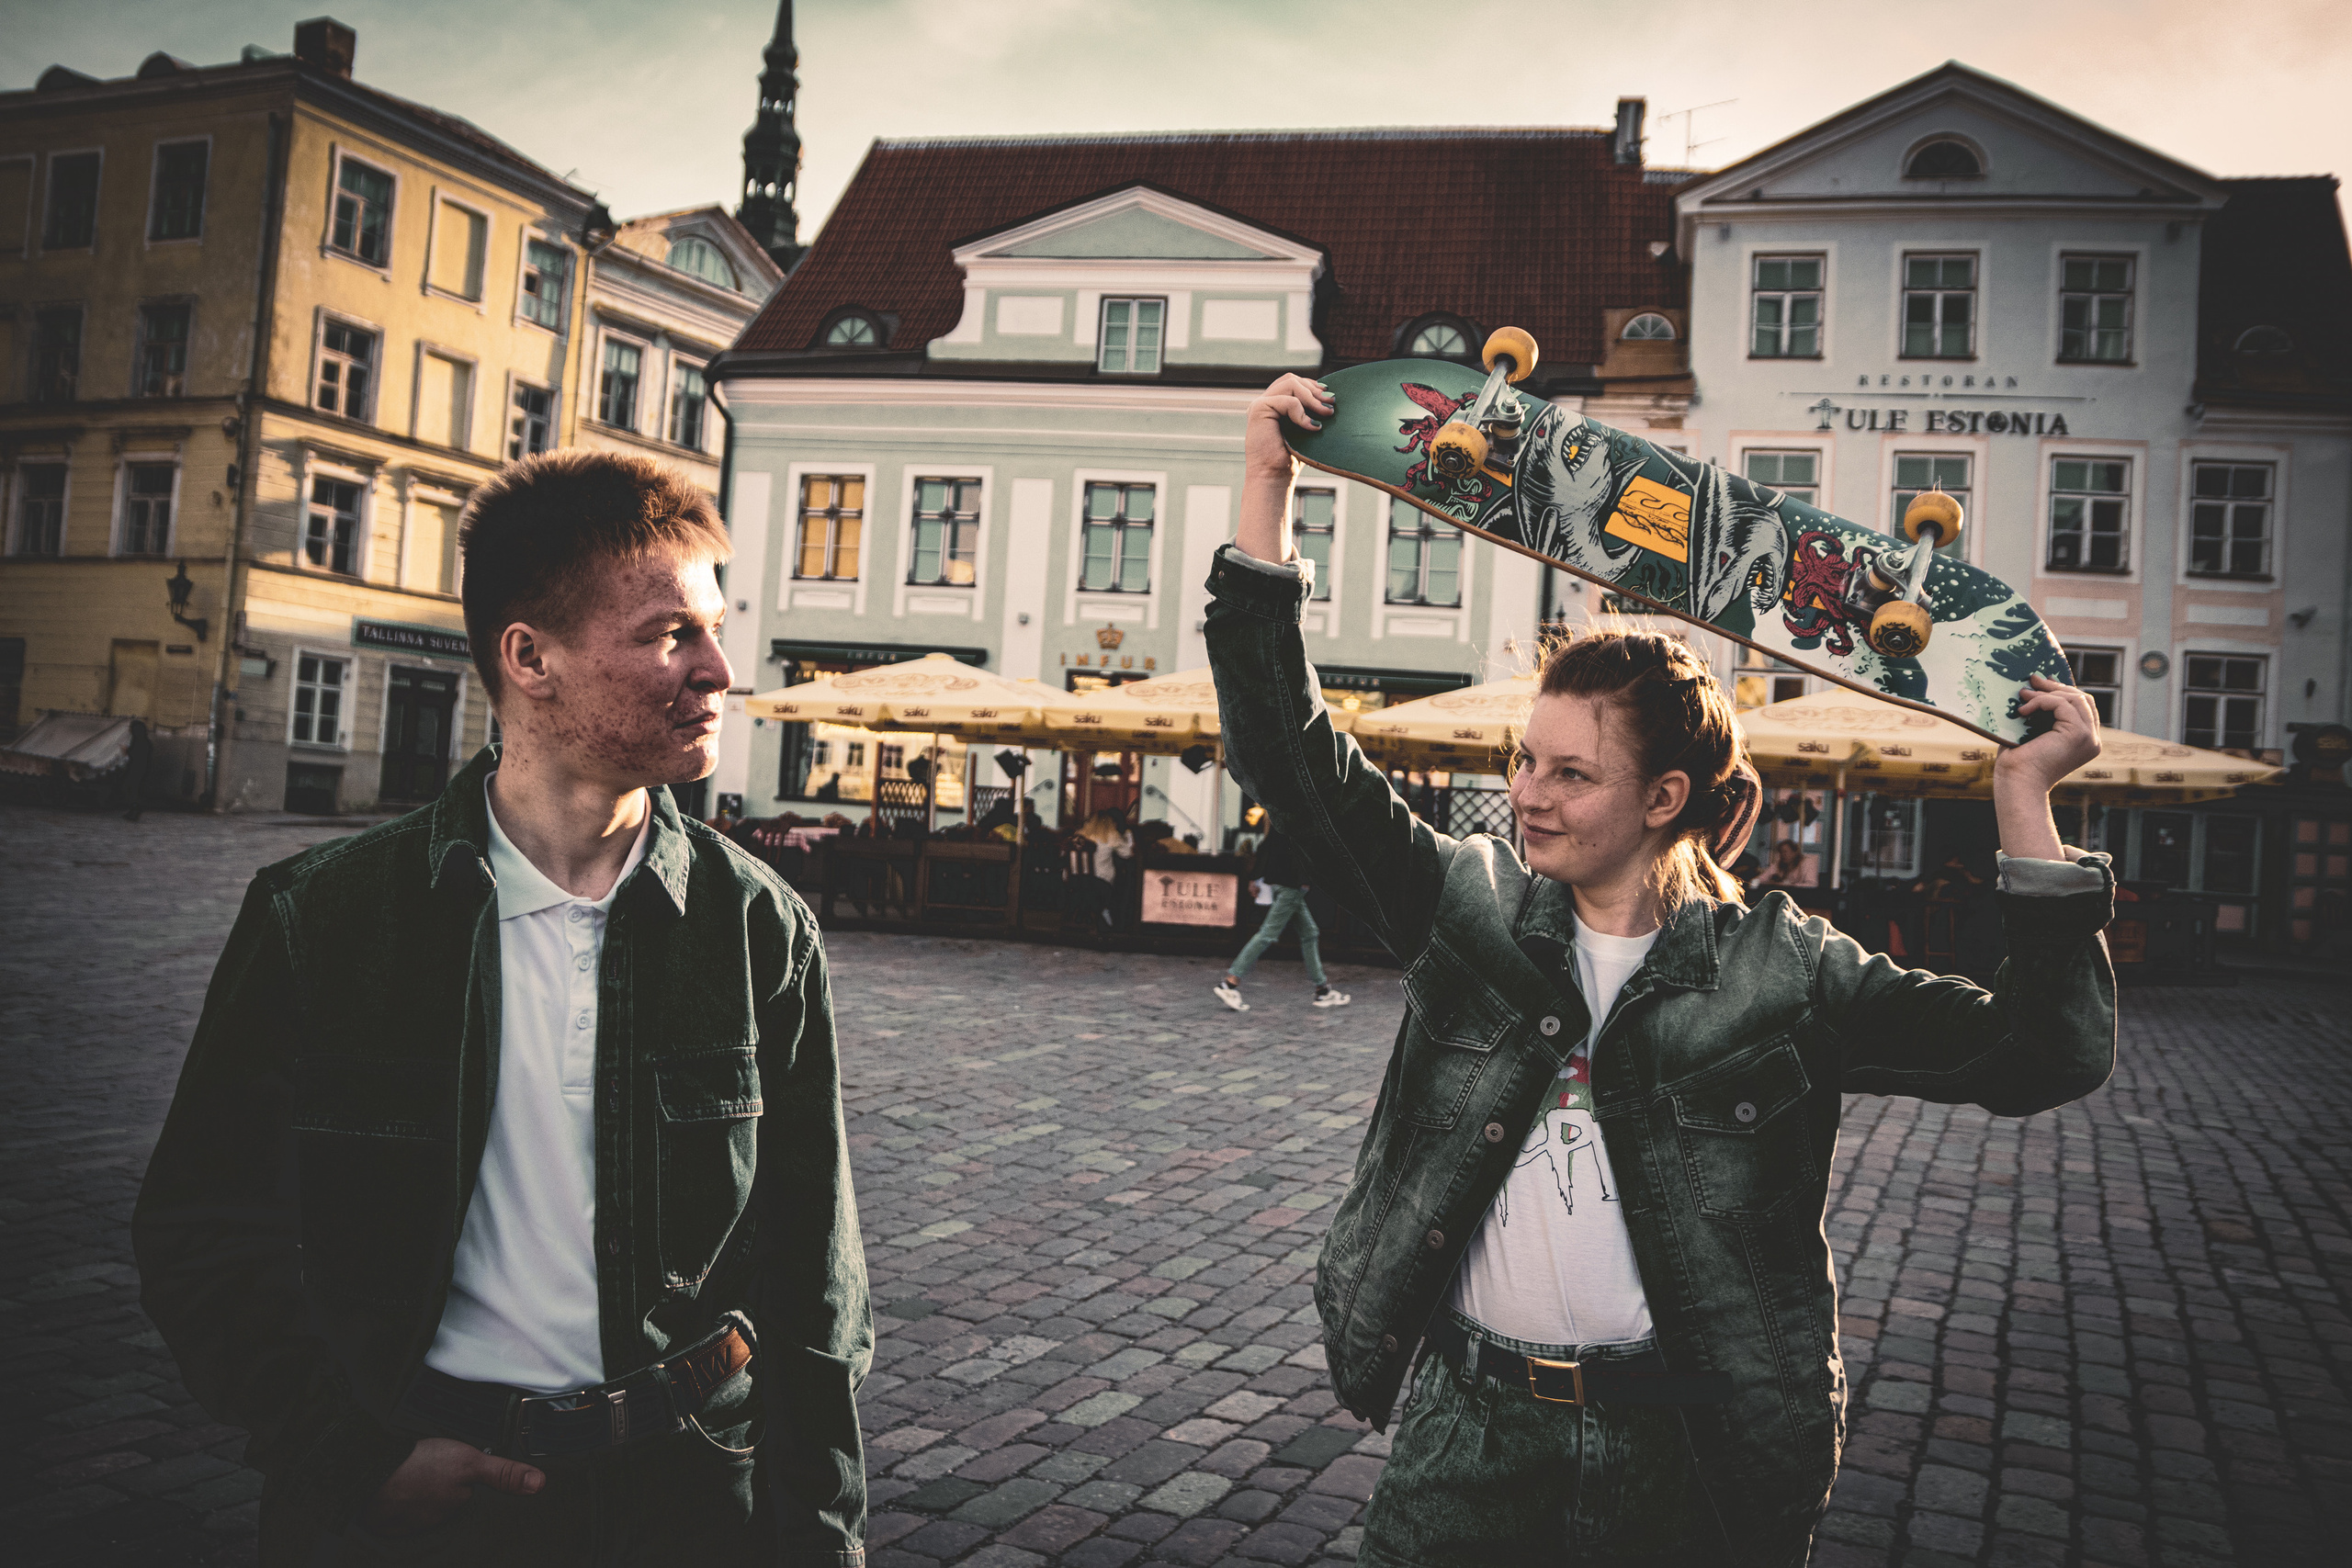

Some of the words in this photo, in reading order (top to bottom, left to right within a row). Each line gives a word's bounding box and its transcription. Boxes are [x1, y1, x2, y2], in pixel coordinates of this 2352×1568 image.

[1858, 374, 2019, 388] RESTORAN
[1927, 409, 2069, 435] ESTONIA
[362, 626, 424, 647] TALLINNA
[1060, 652, 1156, 671] INFUR
[773, 702, 798, 714] saku
[837, 705, 864, 716] saku
[903, 705, 930, 717] saku
[970, 707, 998, 717] saku
[1073, 712, 1101, 724] saku
[1144, 715, 1173, 727] saku
[1453, 727, 1483, 739] saku
[1798, 740, 1829, 753] saku
[1881, 744, 1912, 757] saku
[2084, 769, 2113, 780] saku
[2154, 770, 2185, 782] saku
